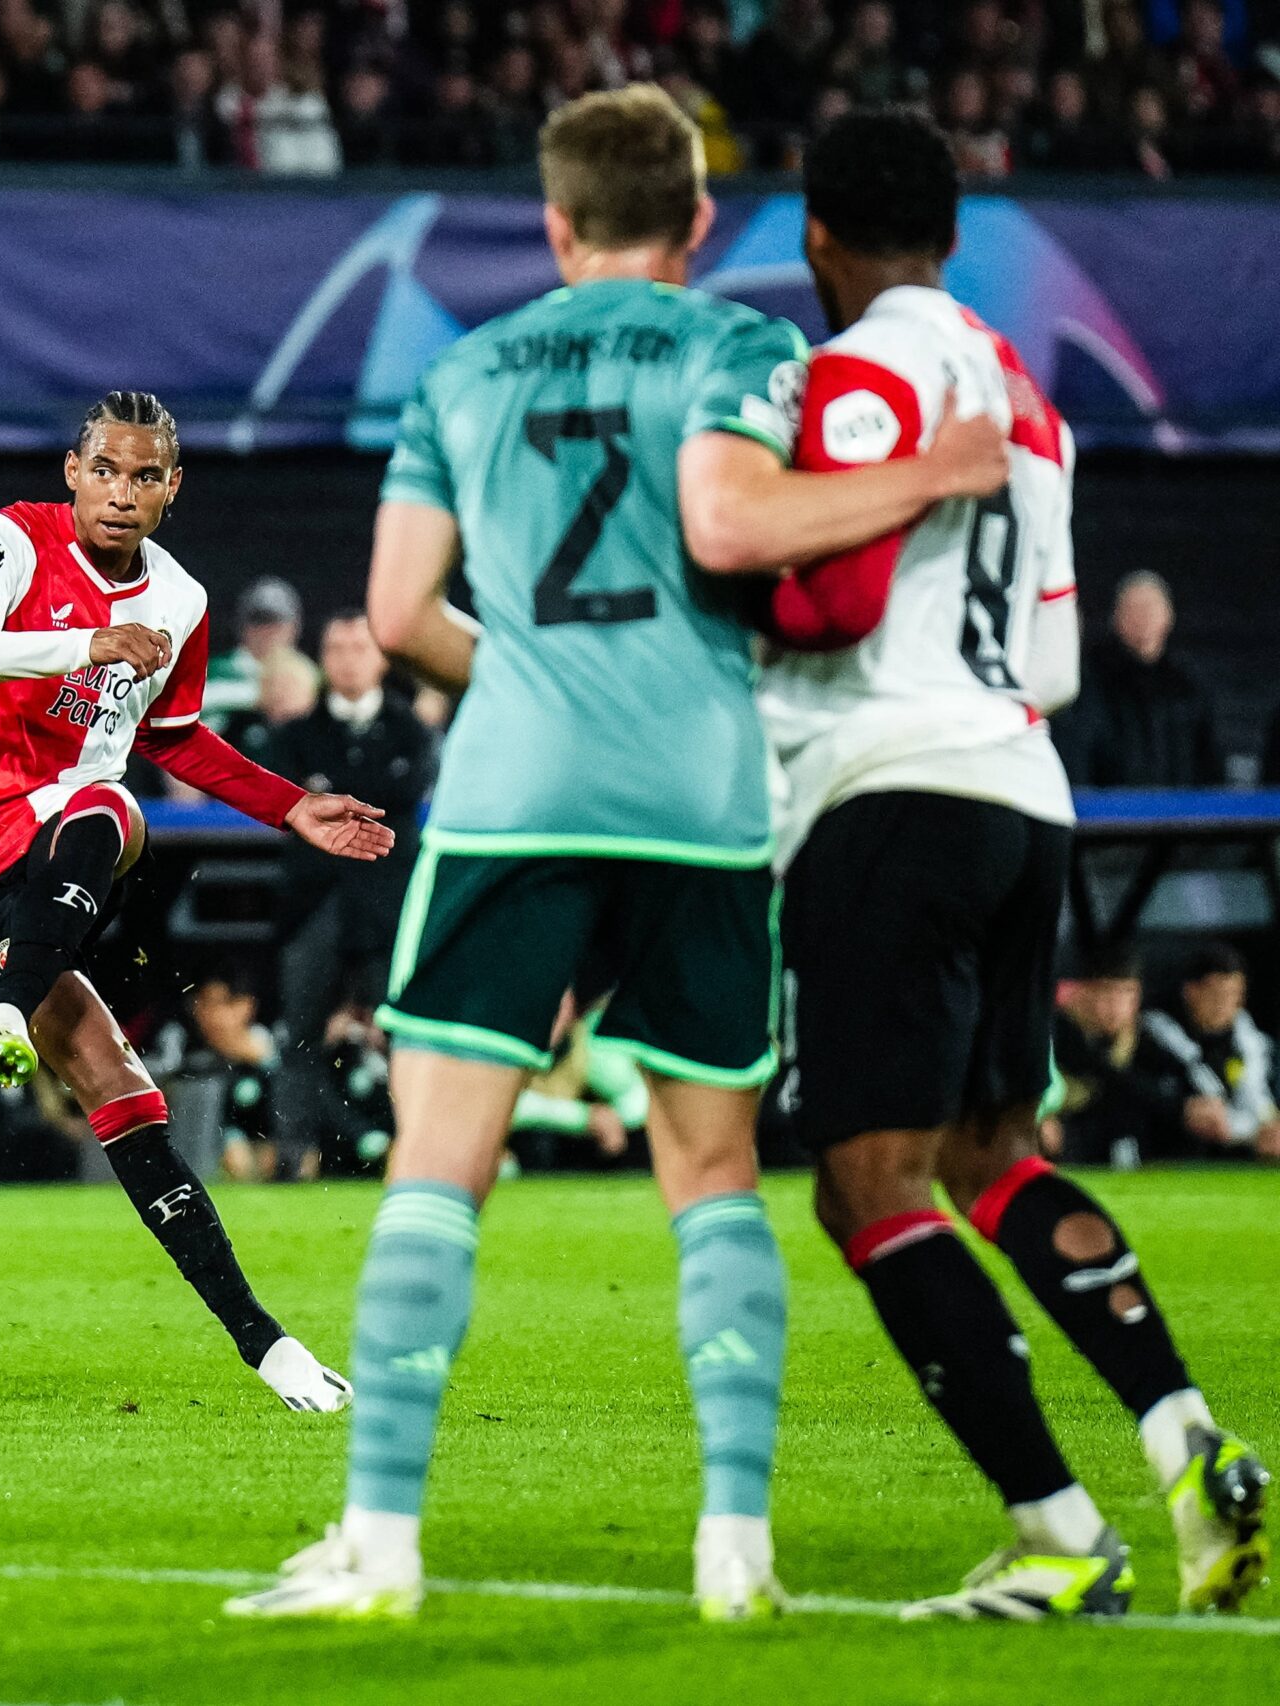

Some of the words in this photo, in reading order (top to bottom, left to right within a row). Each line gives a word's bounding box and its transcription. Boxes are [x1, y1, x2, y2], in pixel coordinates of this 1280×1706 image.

[524, 404, 658, 626] 2
[45, 684, 121, 736] Parcs
[52, 882, 98, 916] F
[148, 1183, 192, 1225] F
